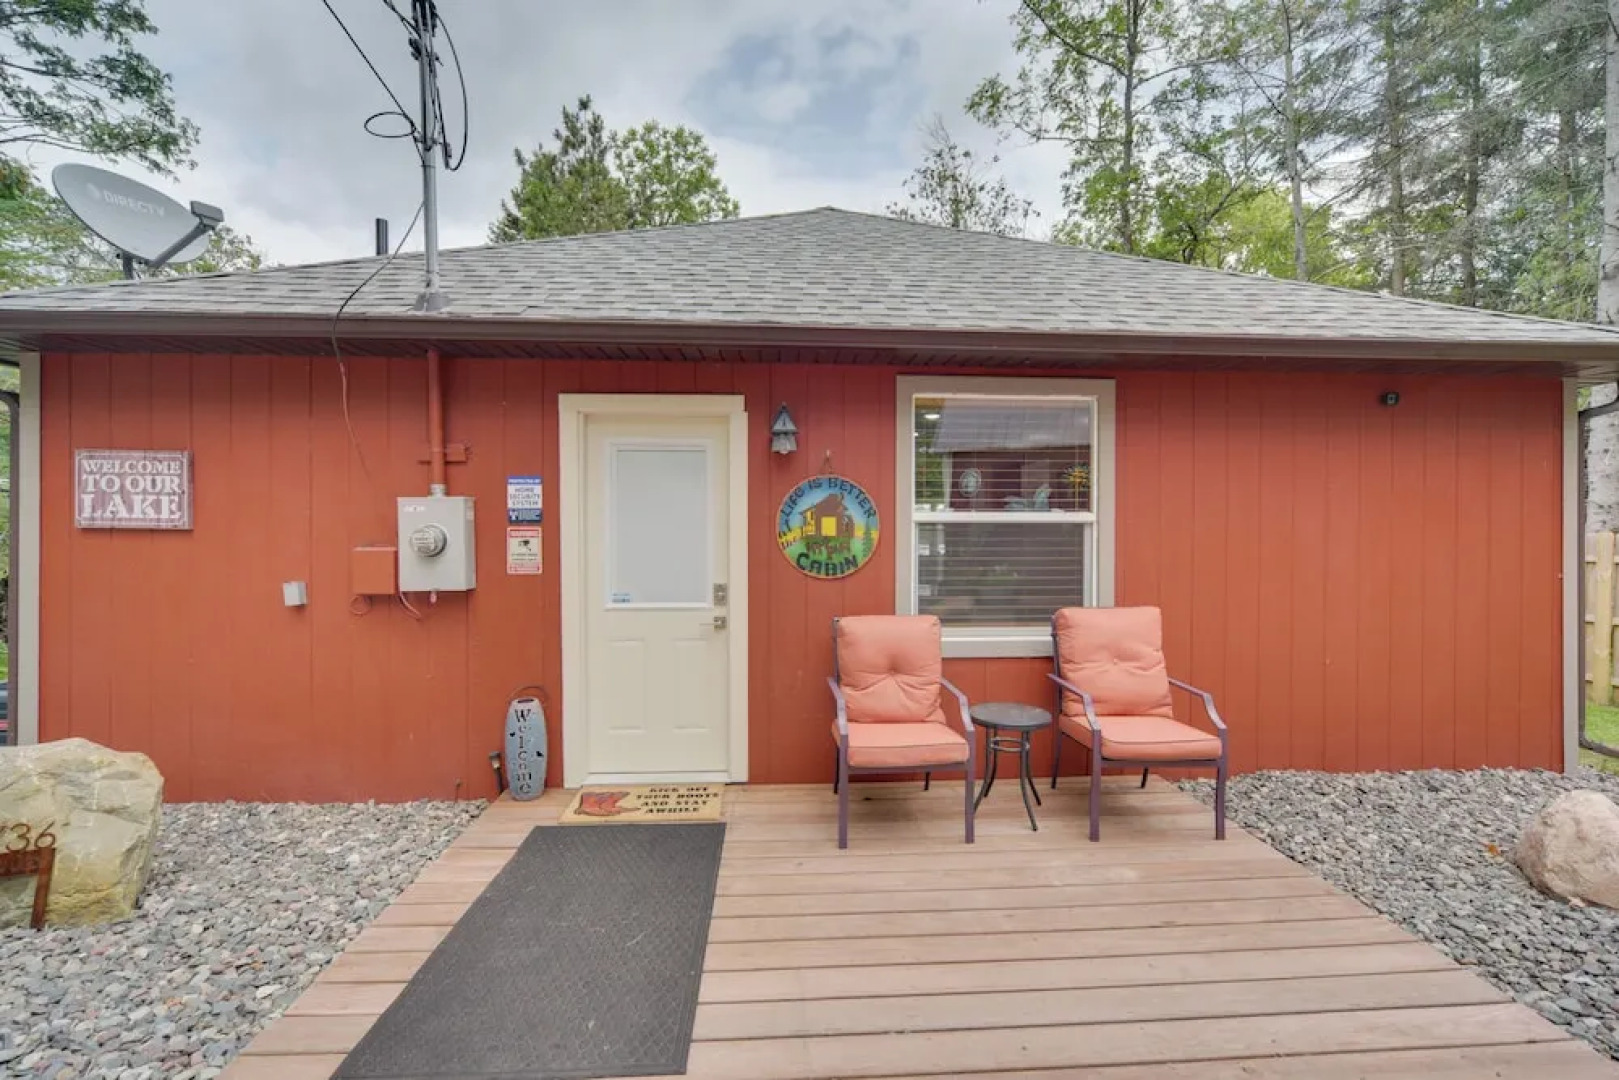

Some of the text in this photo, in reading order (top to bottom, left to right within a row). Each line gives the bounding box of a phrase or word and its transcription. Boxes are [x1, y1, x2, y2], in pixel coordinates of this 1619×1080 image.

[103, 190, 165, 217] DIRECTV
[82, 459, 181, 474] WELCOME
[82, 474, 181, 493] TO OUR
[80, 493, 181, 519] LAKE
[808, 479, 822, 490] IS
[828, 478, 877, 519] BETTER
[796, 552, 858, 576] CABIN
[515, 708, 532, 793] Welcome
